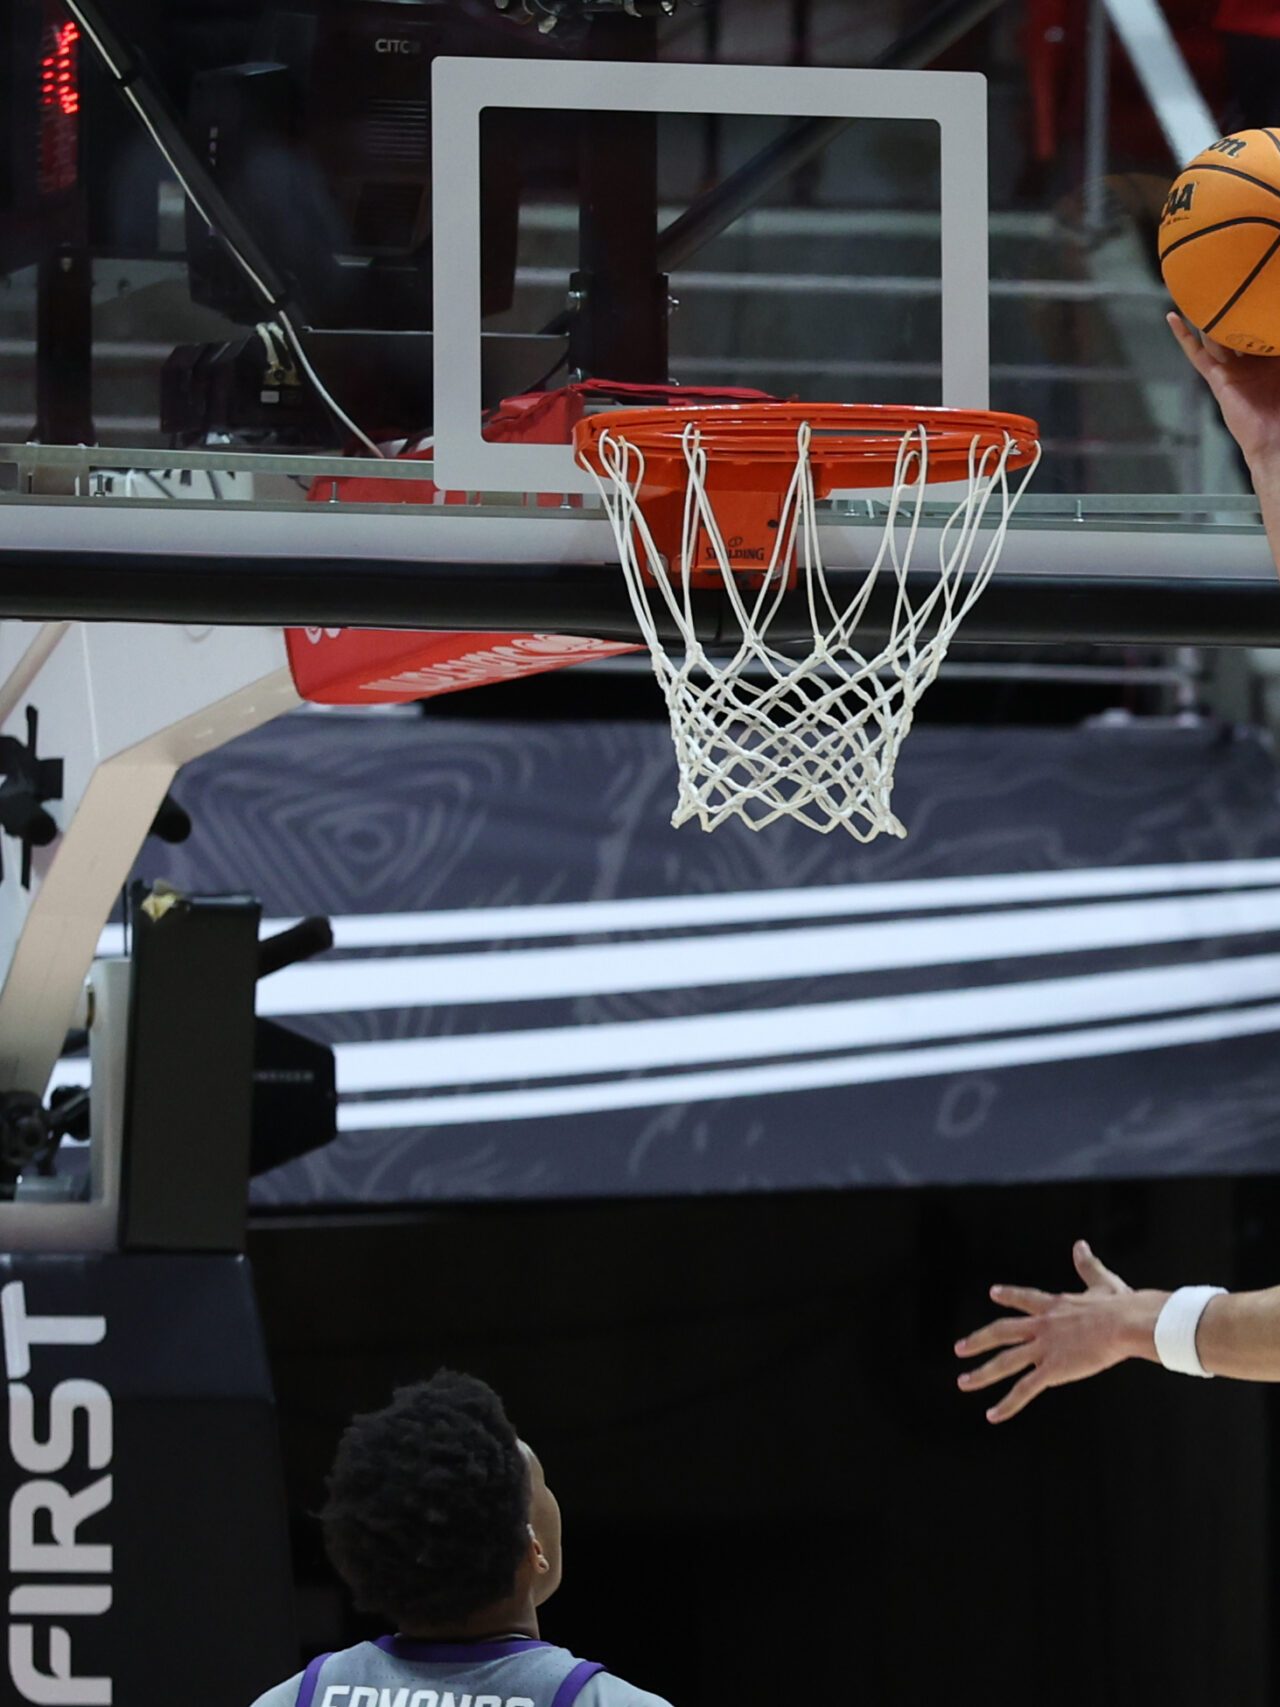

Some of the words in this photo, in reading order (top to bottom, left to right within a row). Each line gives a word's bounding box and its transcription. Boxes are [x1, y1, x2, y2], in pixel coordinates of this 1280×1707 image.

[706, 547, 764, 561] SPLDING
[0, 1280, 113, 1706] FIRST
[321, 1685, 535, 1707] EDMON
